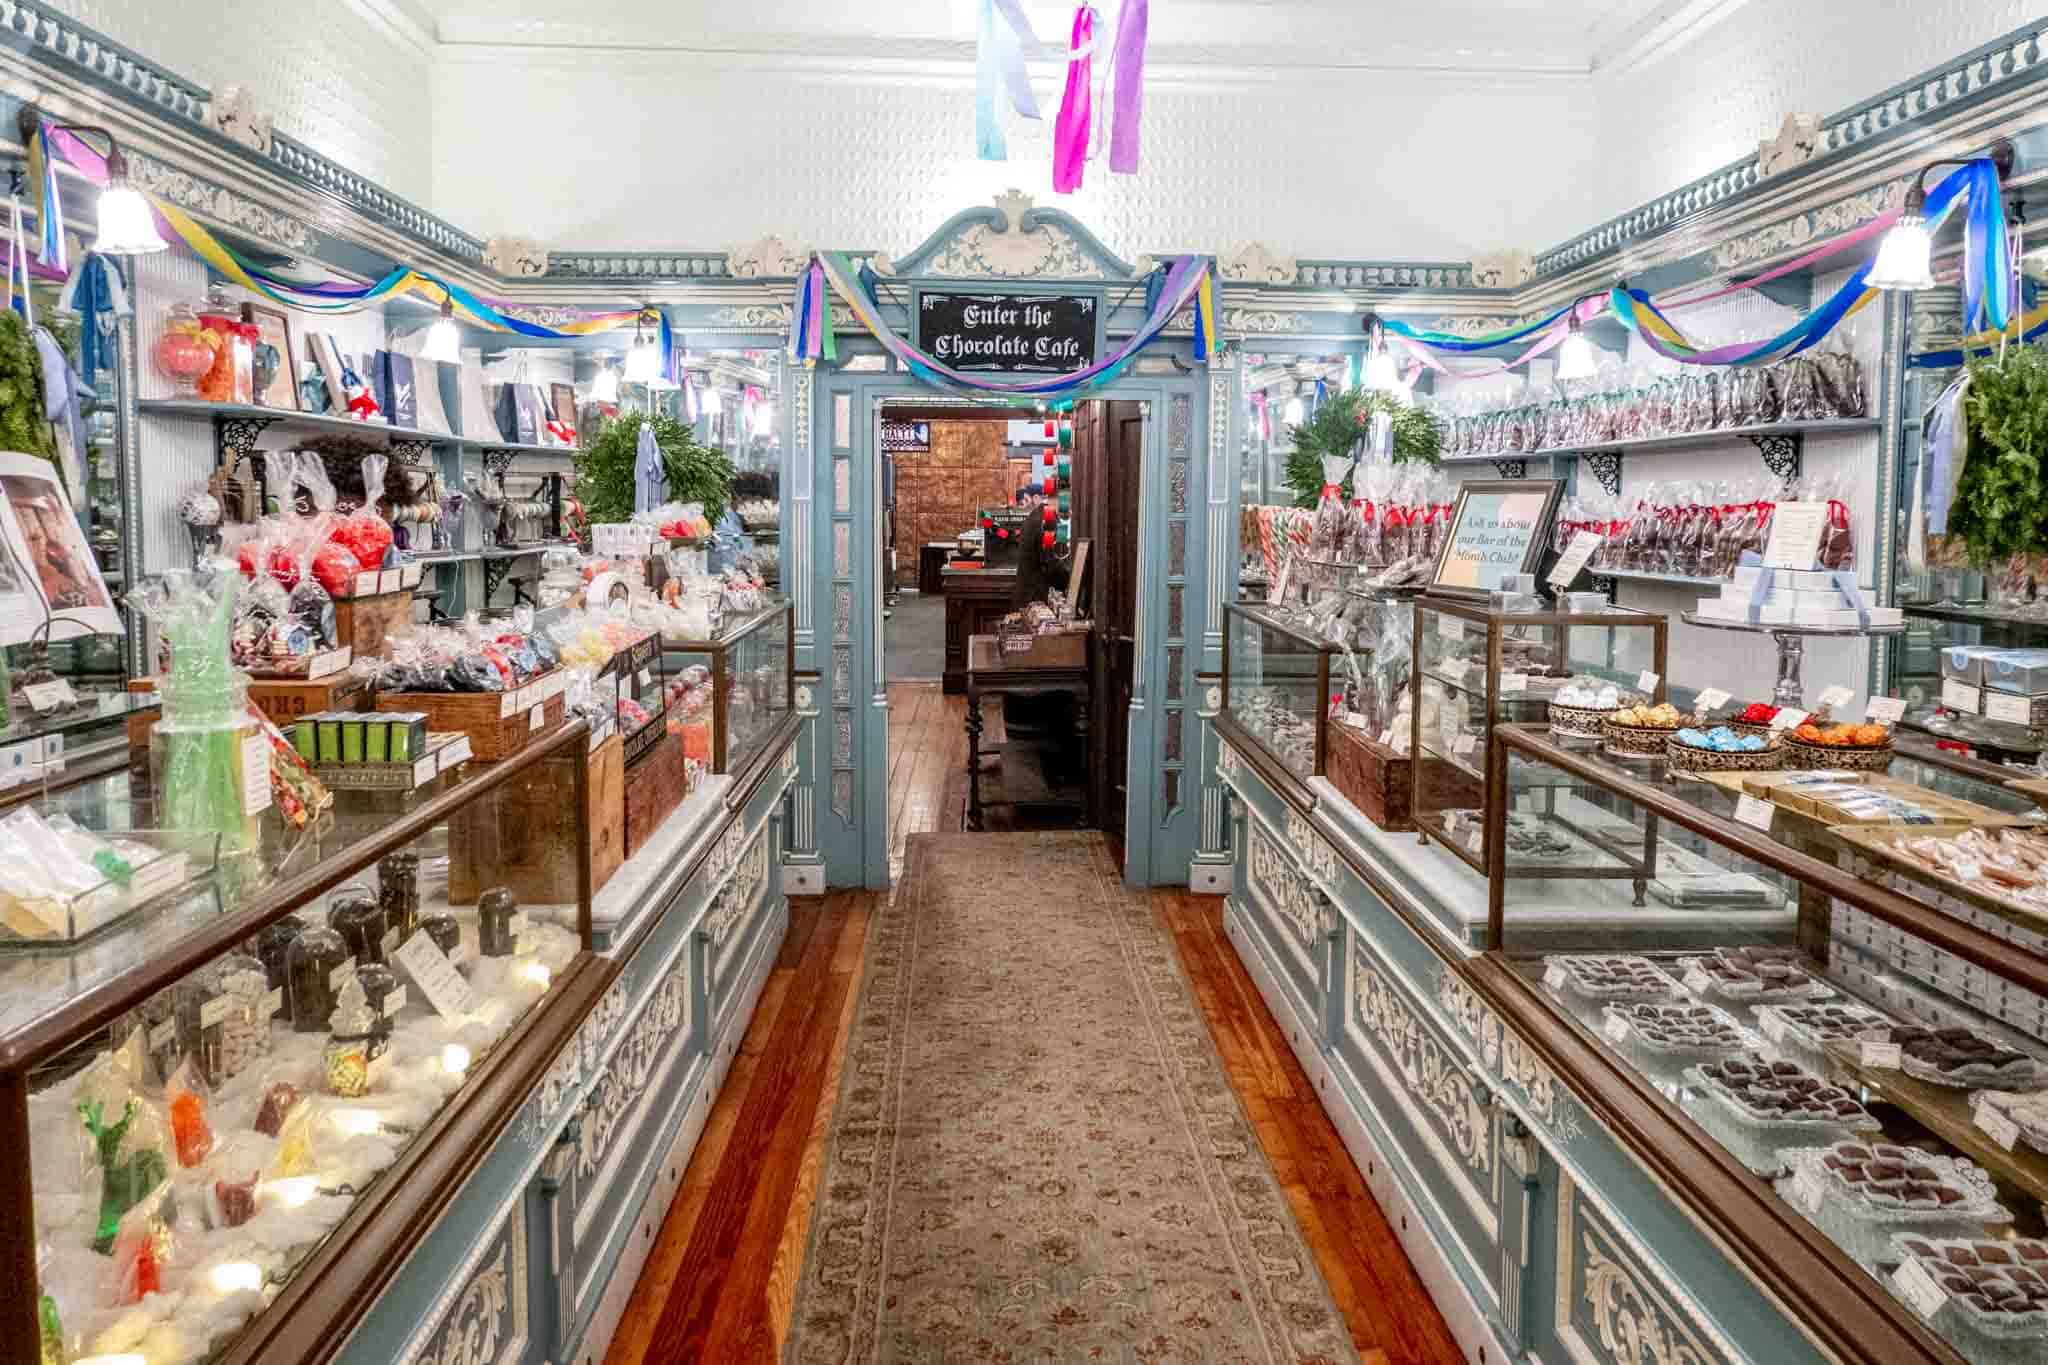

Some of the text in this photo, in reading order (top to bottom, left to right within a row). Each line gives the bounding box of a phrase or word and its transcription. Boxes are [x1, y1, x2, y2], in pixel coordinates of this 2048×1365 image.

[963, 305, 1052, 328] Enter the
[935, 335, 1079, 360] Chocolate Cafe
[1466, 517, 1532, 528] Ask us about
[1457, 533, 1527, 546] our Bar of the
[1456, 551, 1488, 561] Month
